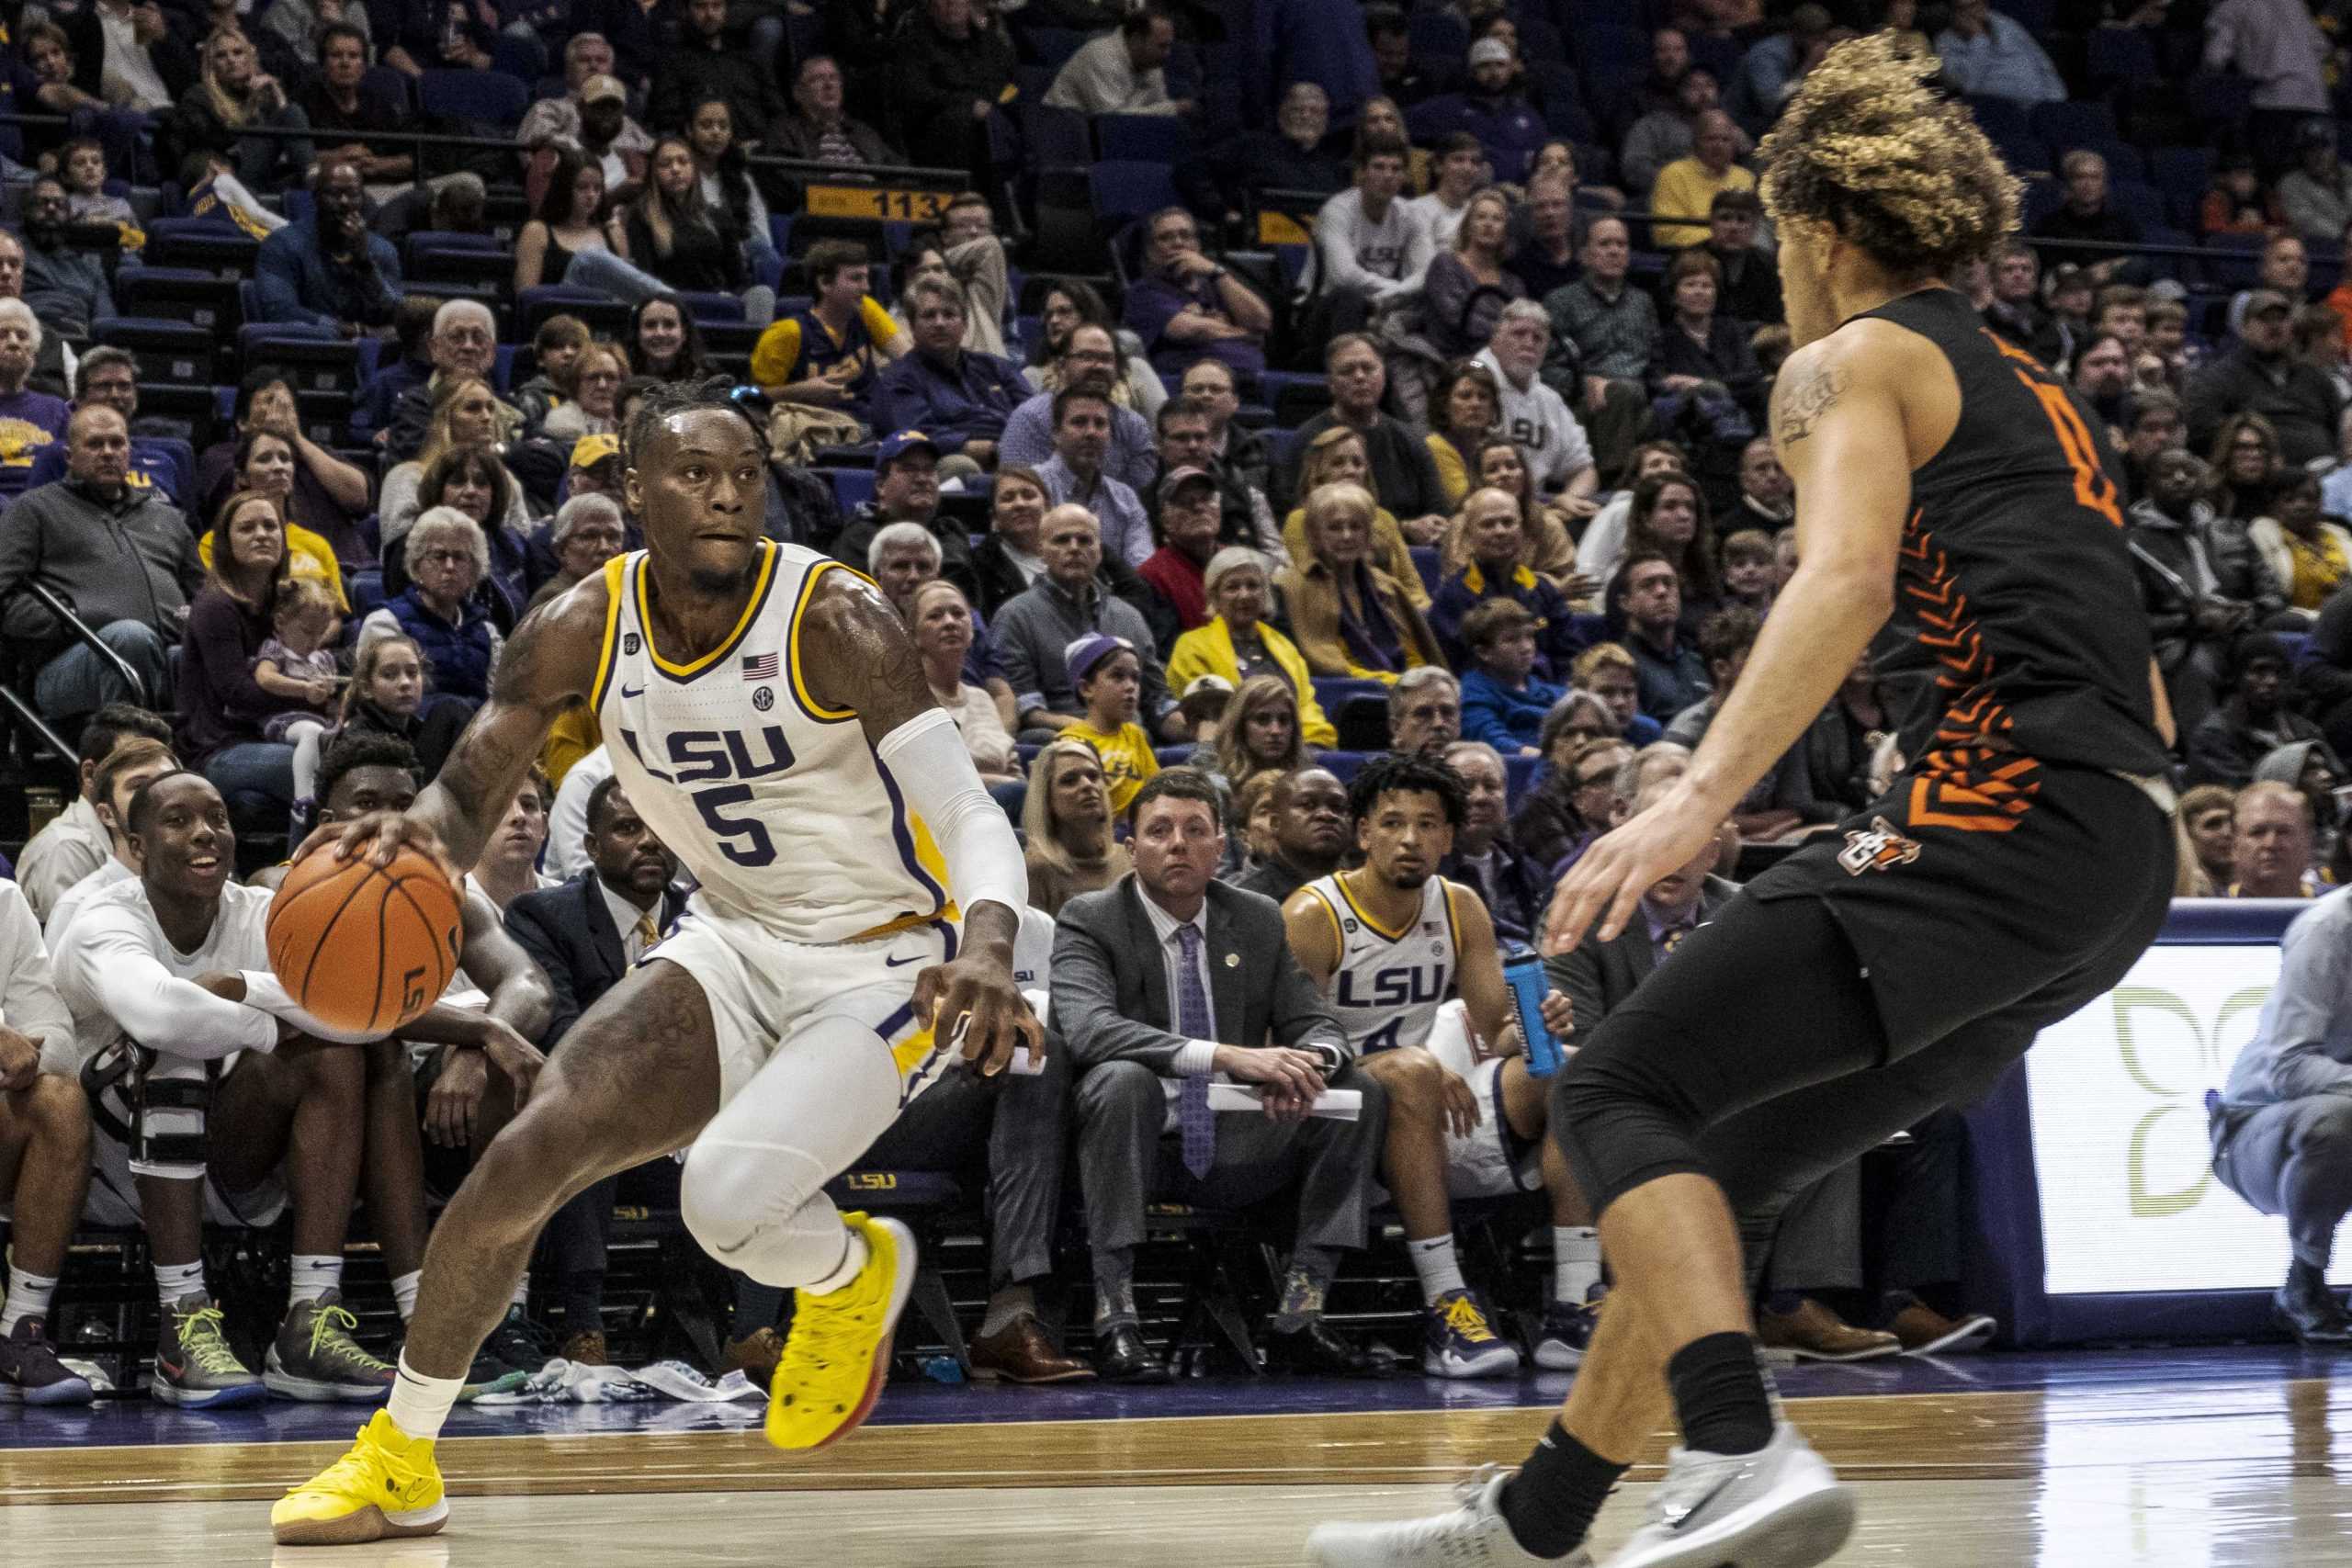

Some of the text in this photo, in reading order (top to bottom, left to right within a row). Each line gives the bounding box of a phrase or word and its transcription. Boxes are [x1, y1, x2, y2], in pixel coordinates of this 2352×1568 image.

[1514, 418, 1548, 450] SU
[620, 725, 796, 784] LSU
[691, 784, 777, 867] 5
[1013, 970, 1035, 982] SU
[1338, 964, 1445, 1008] LSU
[1363, 1016, 1406, 1055] 4
[847, 1174, 898, 1190] LSU
